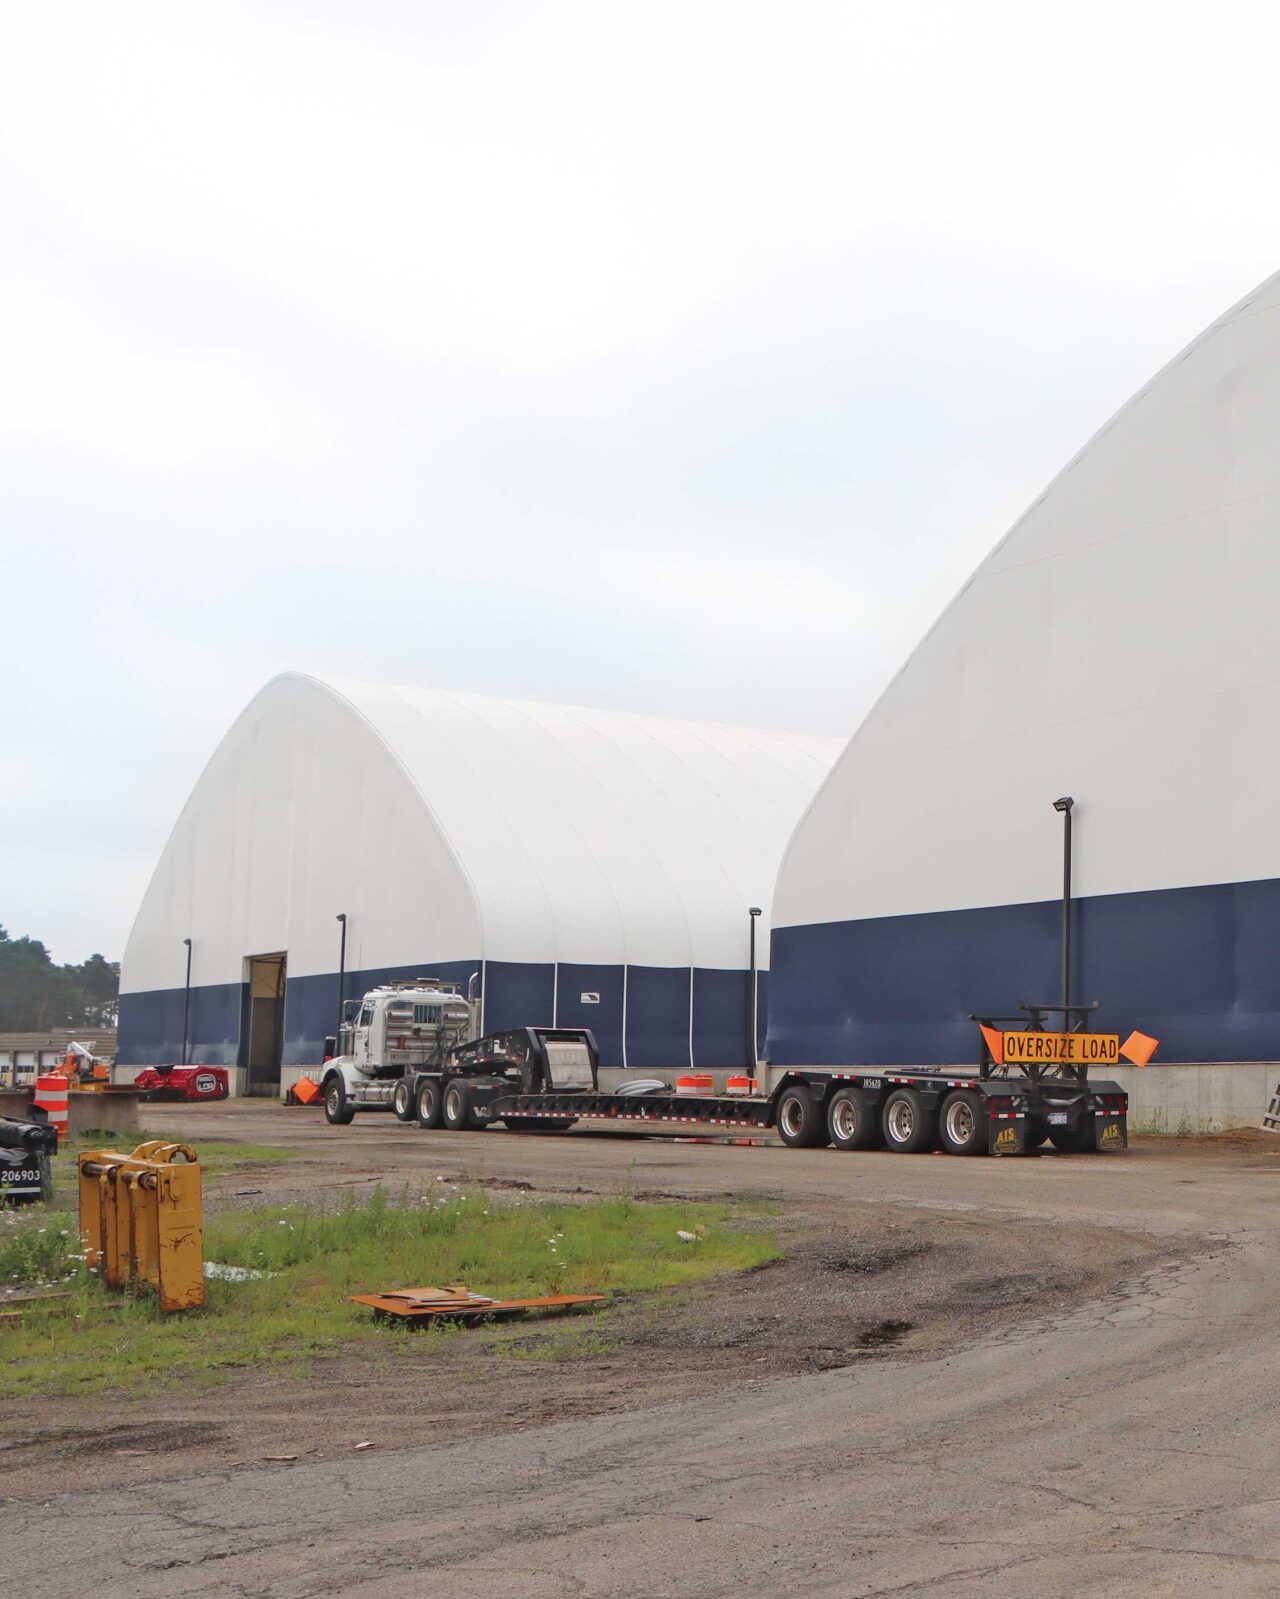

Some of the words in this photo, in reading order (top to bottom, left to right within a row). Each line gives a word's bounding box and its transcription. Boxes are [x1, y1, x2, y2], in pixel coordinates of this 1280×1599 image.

[1007, 1037, 1075, 1058] OVERSIZE
[1082, 1039, 1117, 1058] LOAD
[997, 1128, 1015, 1143] AIS
[1102, 1124, 1118, 1139] AIS
[1, 1170, 41, 1181] 206903
